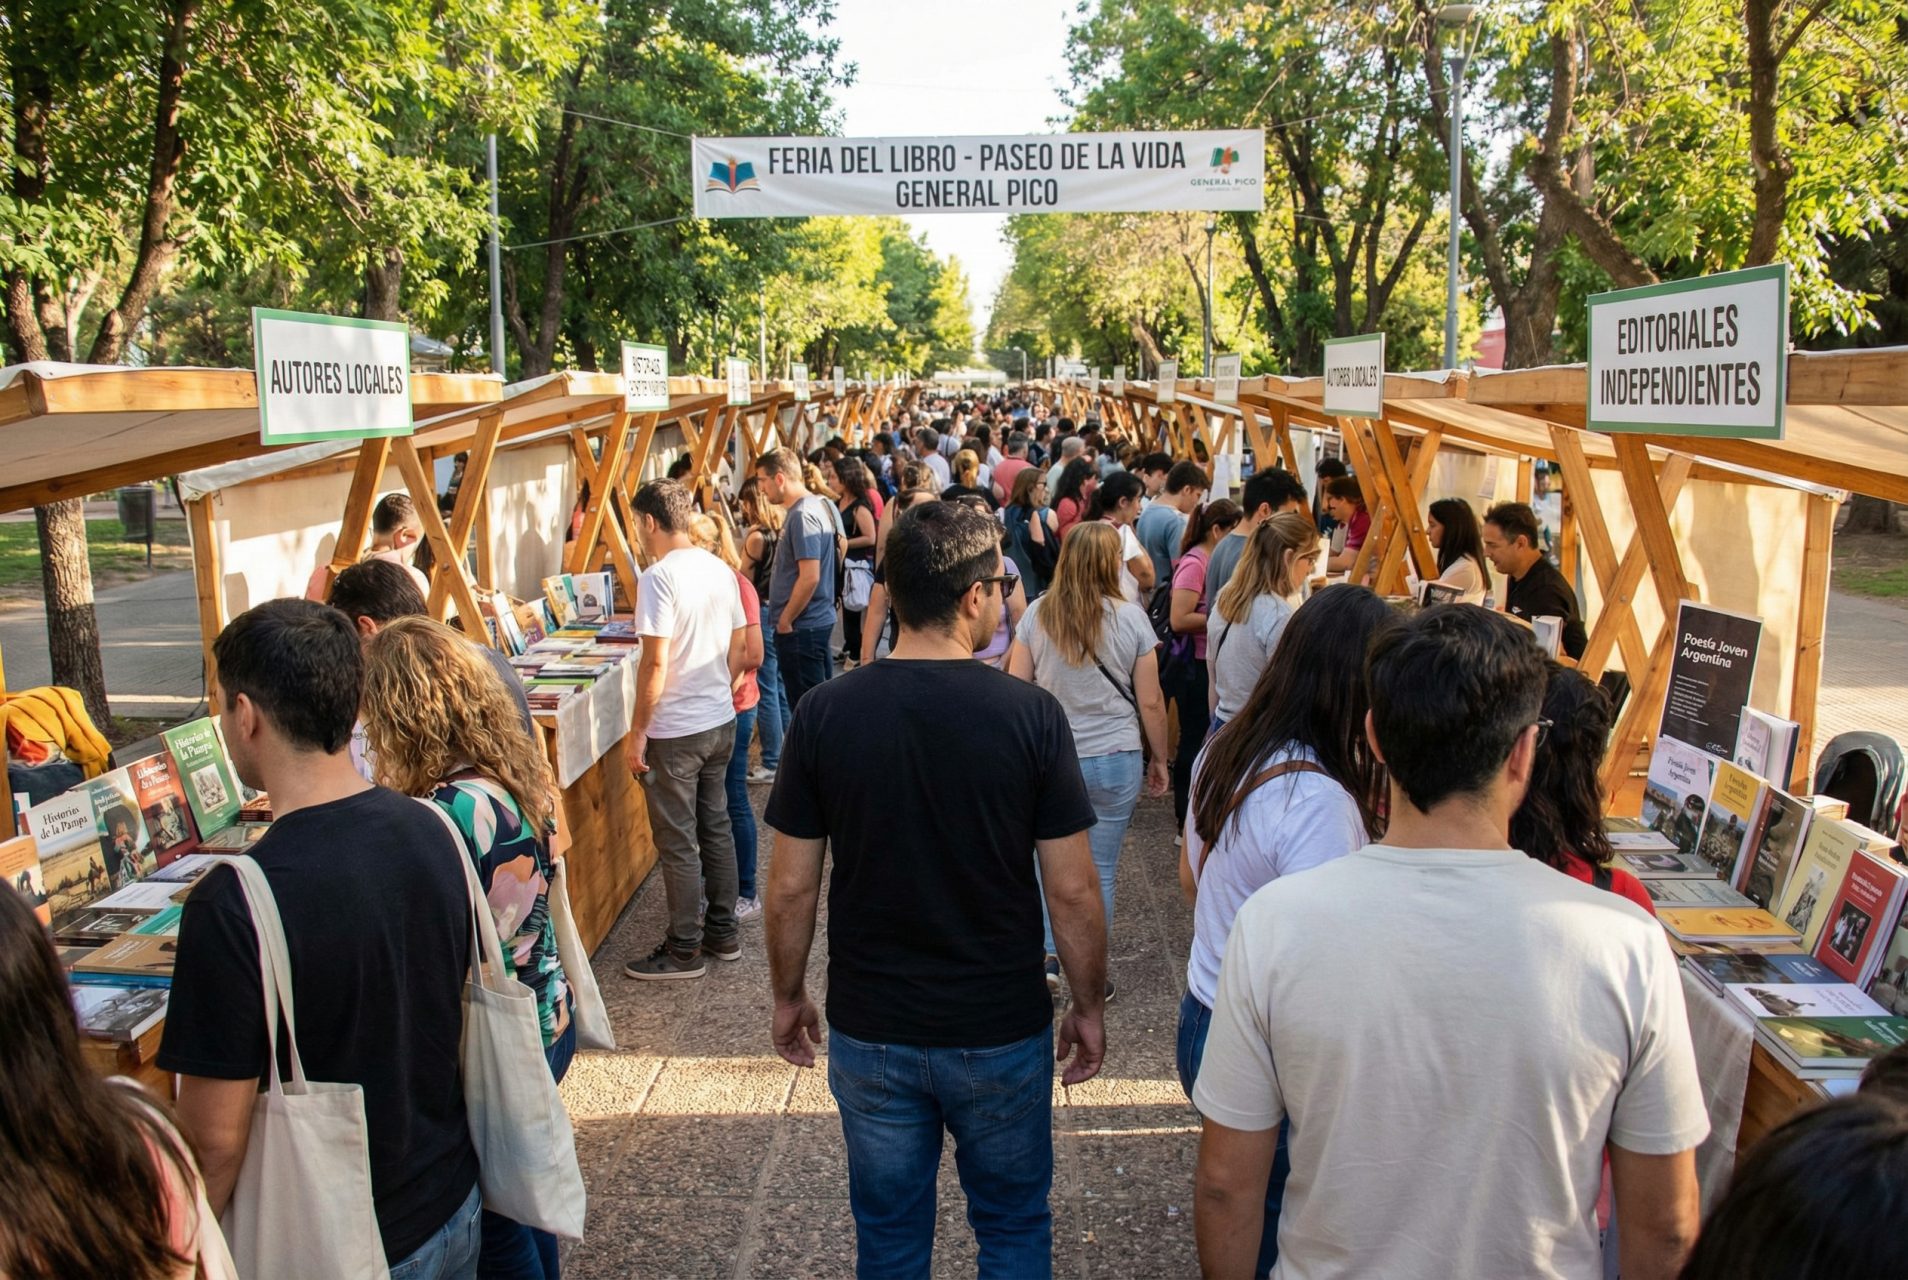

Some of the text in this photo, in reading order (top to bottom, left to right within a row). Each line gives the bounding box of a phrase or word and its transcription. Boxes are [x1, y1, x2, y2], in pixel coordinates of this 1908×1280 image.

[769, 146, 834, 174] FERIA
[841, 146, 883, 174] DEL
[890, 145, 956, 173] LIBRO
[980, 143, 1053, 171] PASEO
[1061, 142, 1089, 170] DE
[1097, 142, 1124, 170] LA
[1132, 141, 1186, 169] VIDA
[896, 178, 1058, 208] GENERAL PICO
[1190, 178, 1257, 186] GENERAL PICO
[1618, 304, 1738, 355] EDITORIALES
[271, 359, 403, 394] AUTORES LOCALES
[1351, 365, 1378, 387] LOCALES
[1601, 361, 1761, 406] INDEPENDIENTES
[1717, 640, 1748, 658] Joven
[41, 828, 50, 840] de
[51, 825, 60, 835] la
